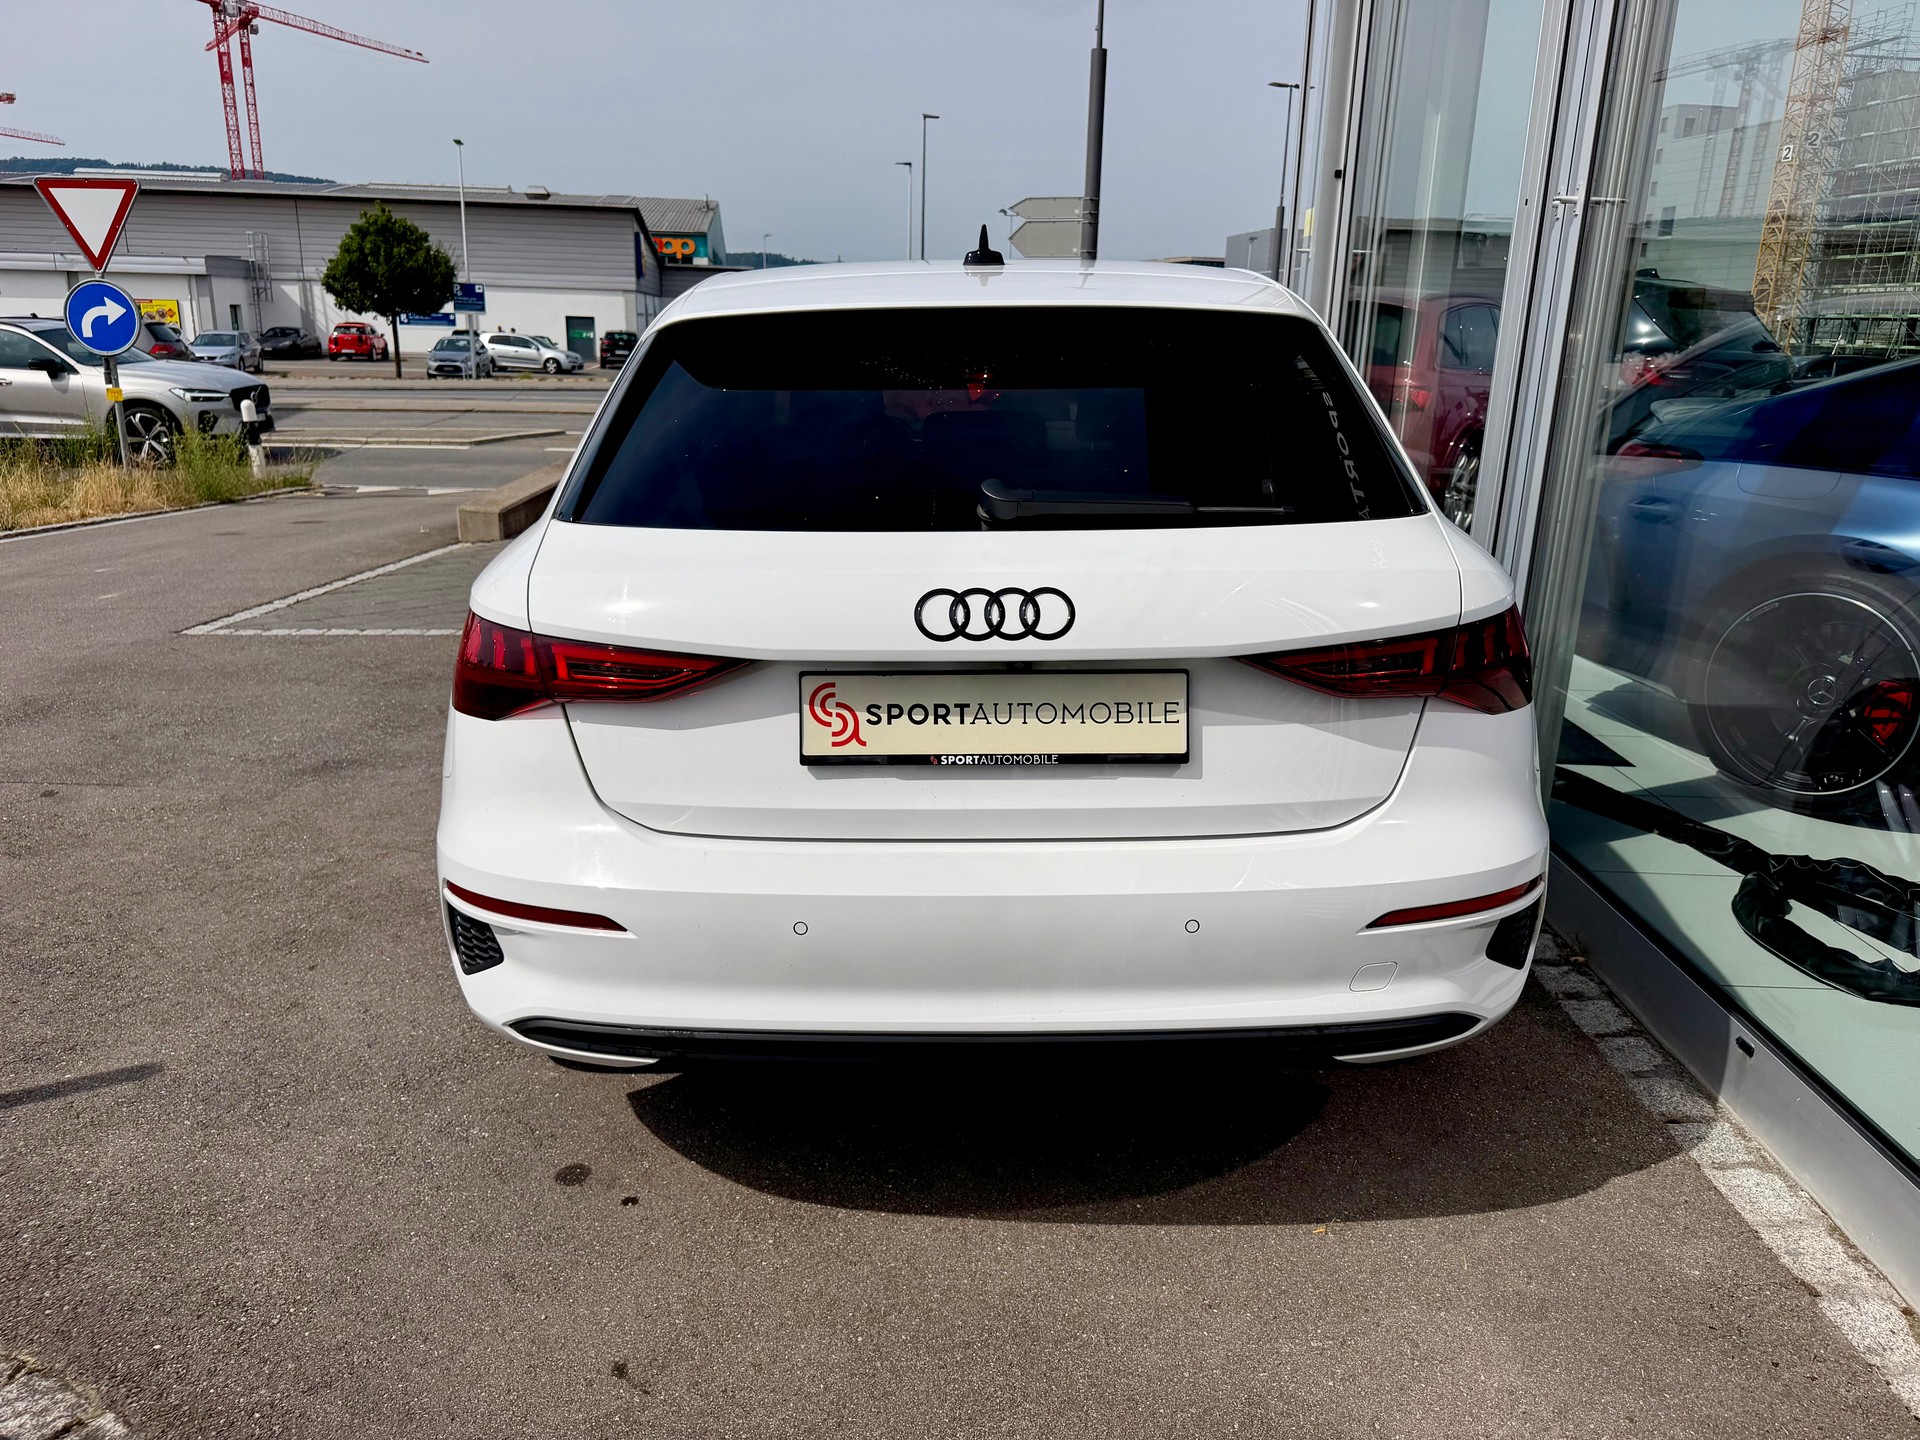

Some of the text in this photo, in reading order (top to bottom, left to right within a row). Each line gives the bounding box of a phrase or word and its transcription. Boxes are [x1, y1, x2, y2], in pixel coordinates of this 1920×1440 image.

[1782, 146, 1792, 161] 2
[865, 701, 1180, 726] SPORTAUTOMOBILE
[940, 754, 1059, 765] SPORTAUTOMOBILE
